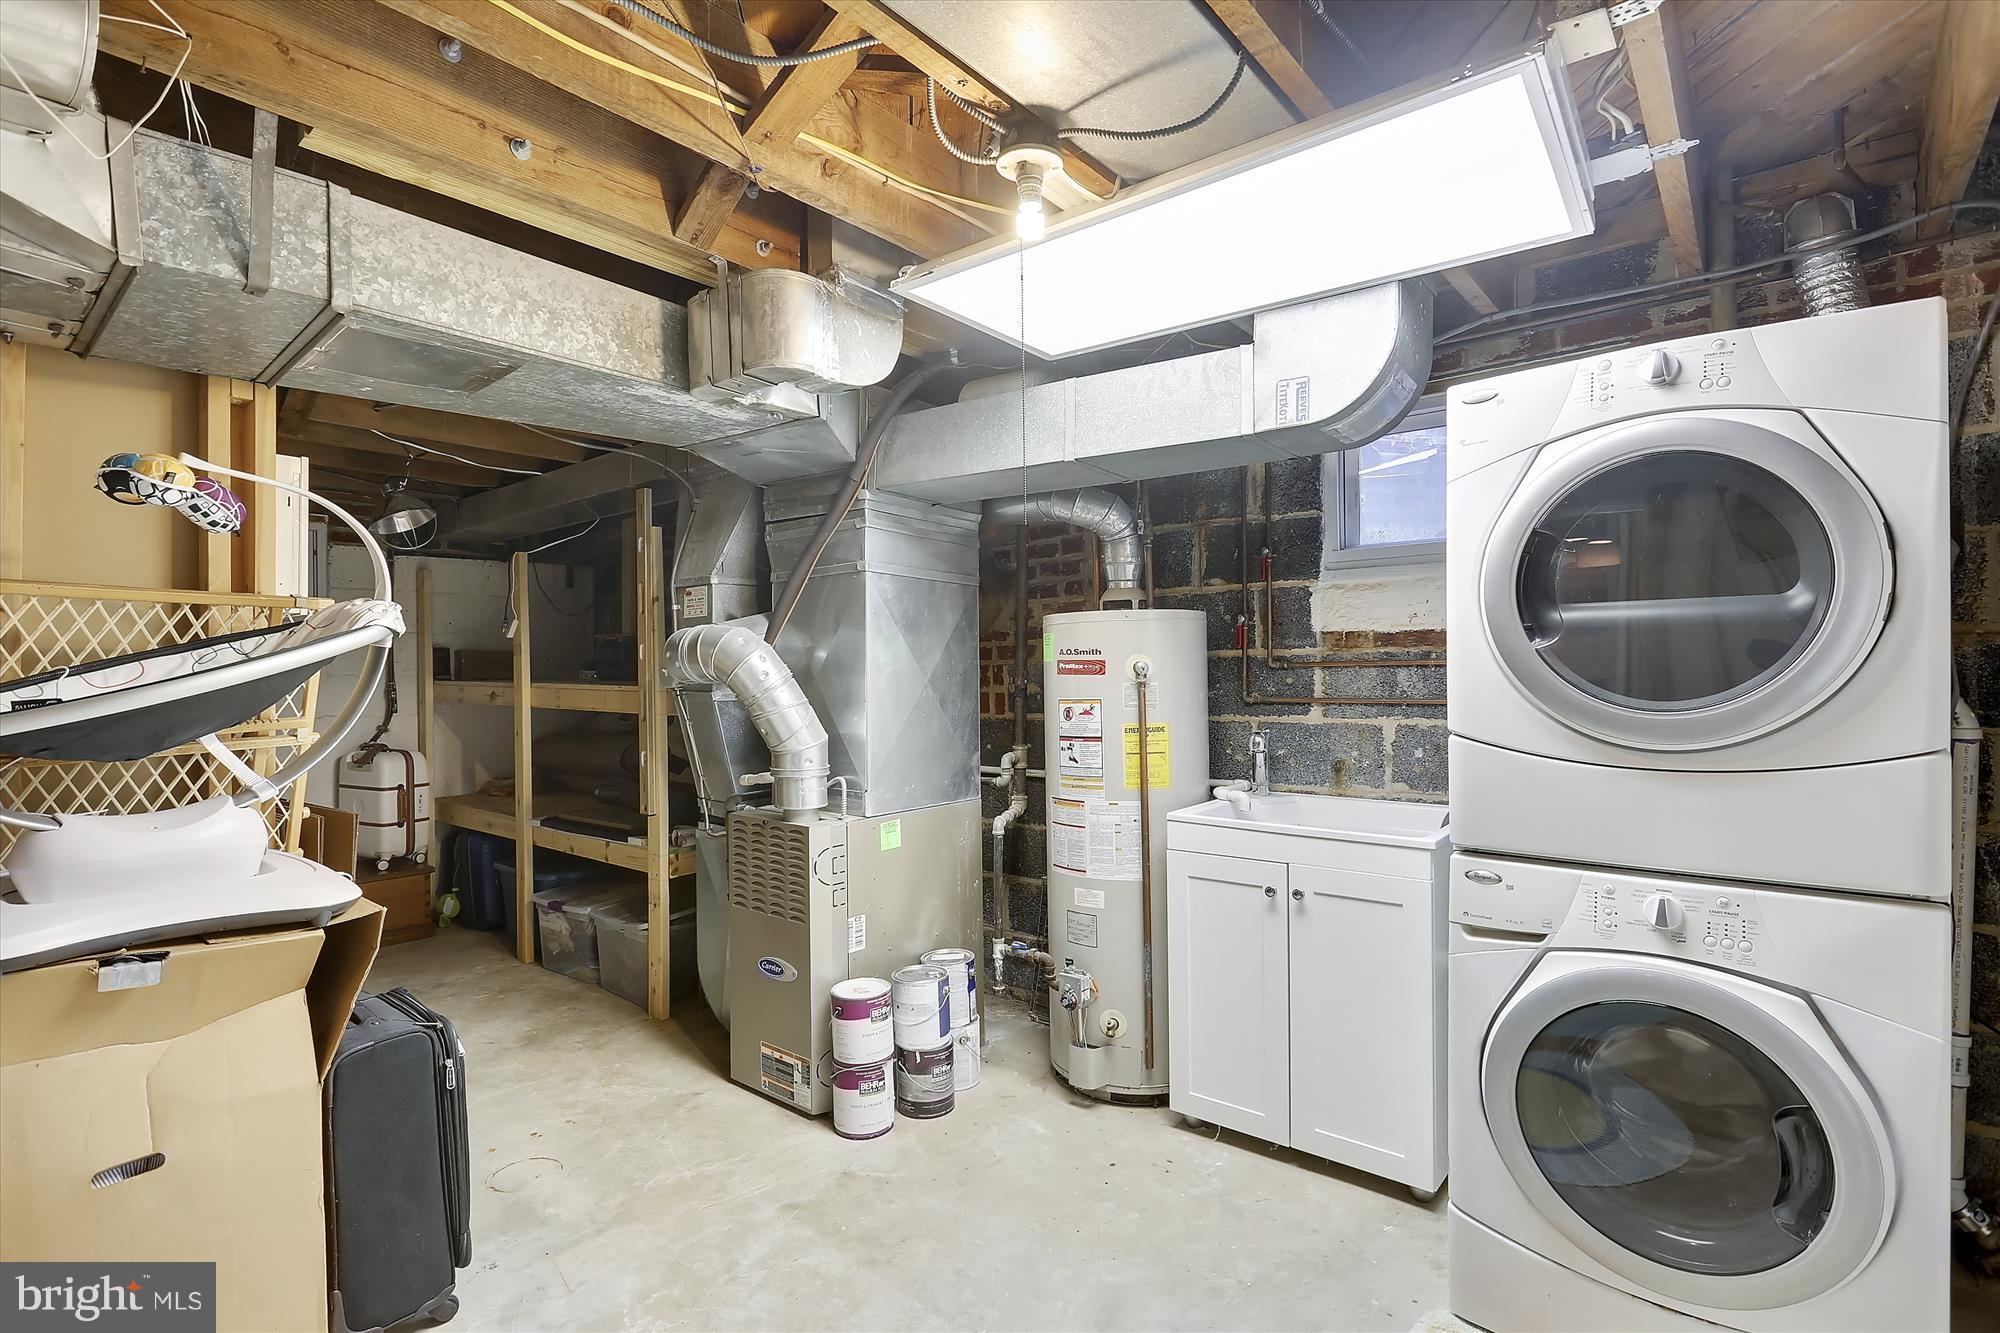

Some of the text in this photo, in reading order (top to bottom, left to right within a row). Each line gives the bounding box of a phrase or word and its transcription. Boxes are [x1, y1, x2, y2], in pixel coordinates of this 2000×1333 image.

[1279, 382, 1289, 427] TITEKOTE
[1295, 381, 1307, 422] REEVES
[762, 961, 782, 972] Carrier
[872, 1005, 889, 1017] BEHR
[860, 1080, 879, 1091] BEHR
